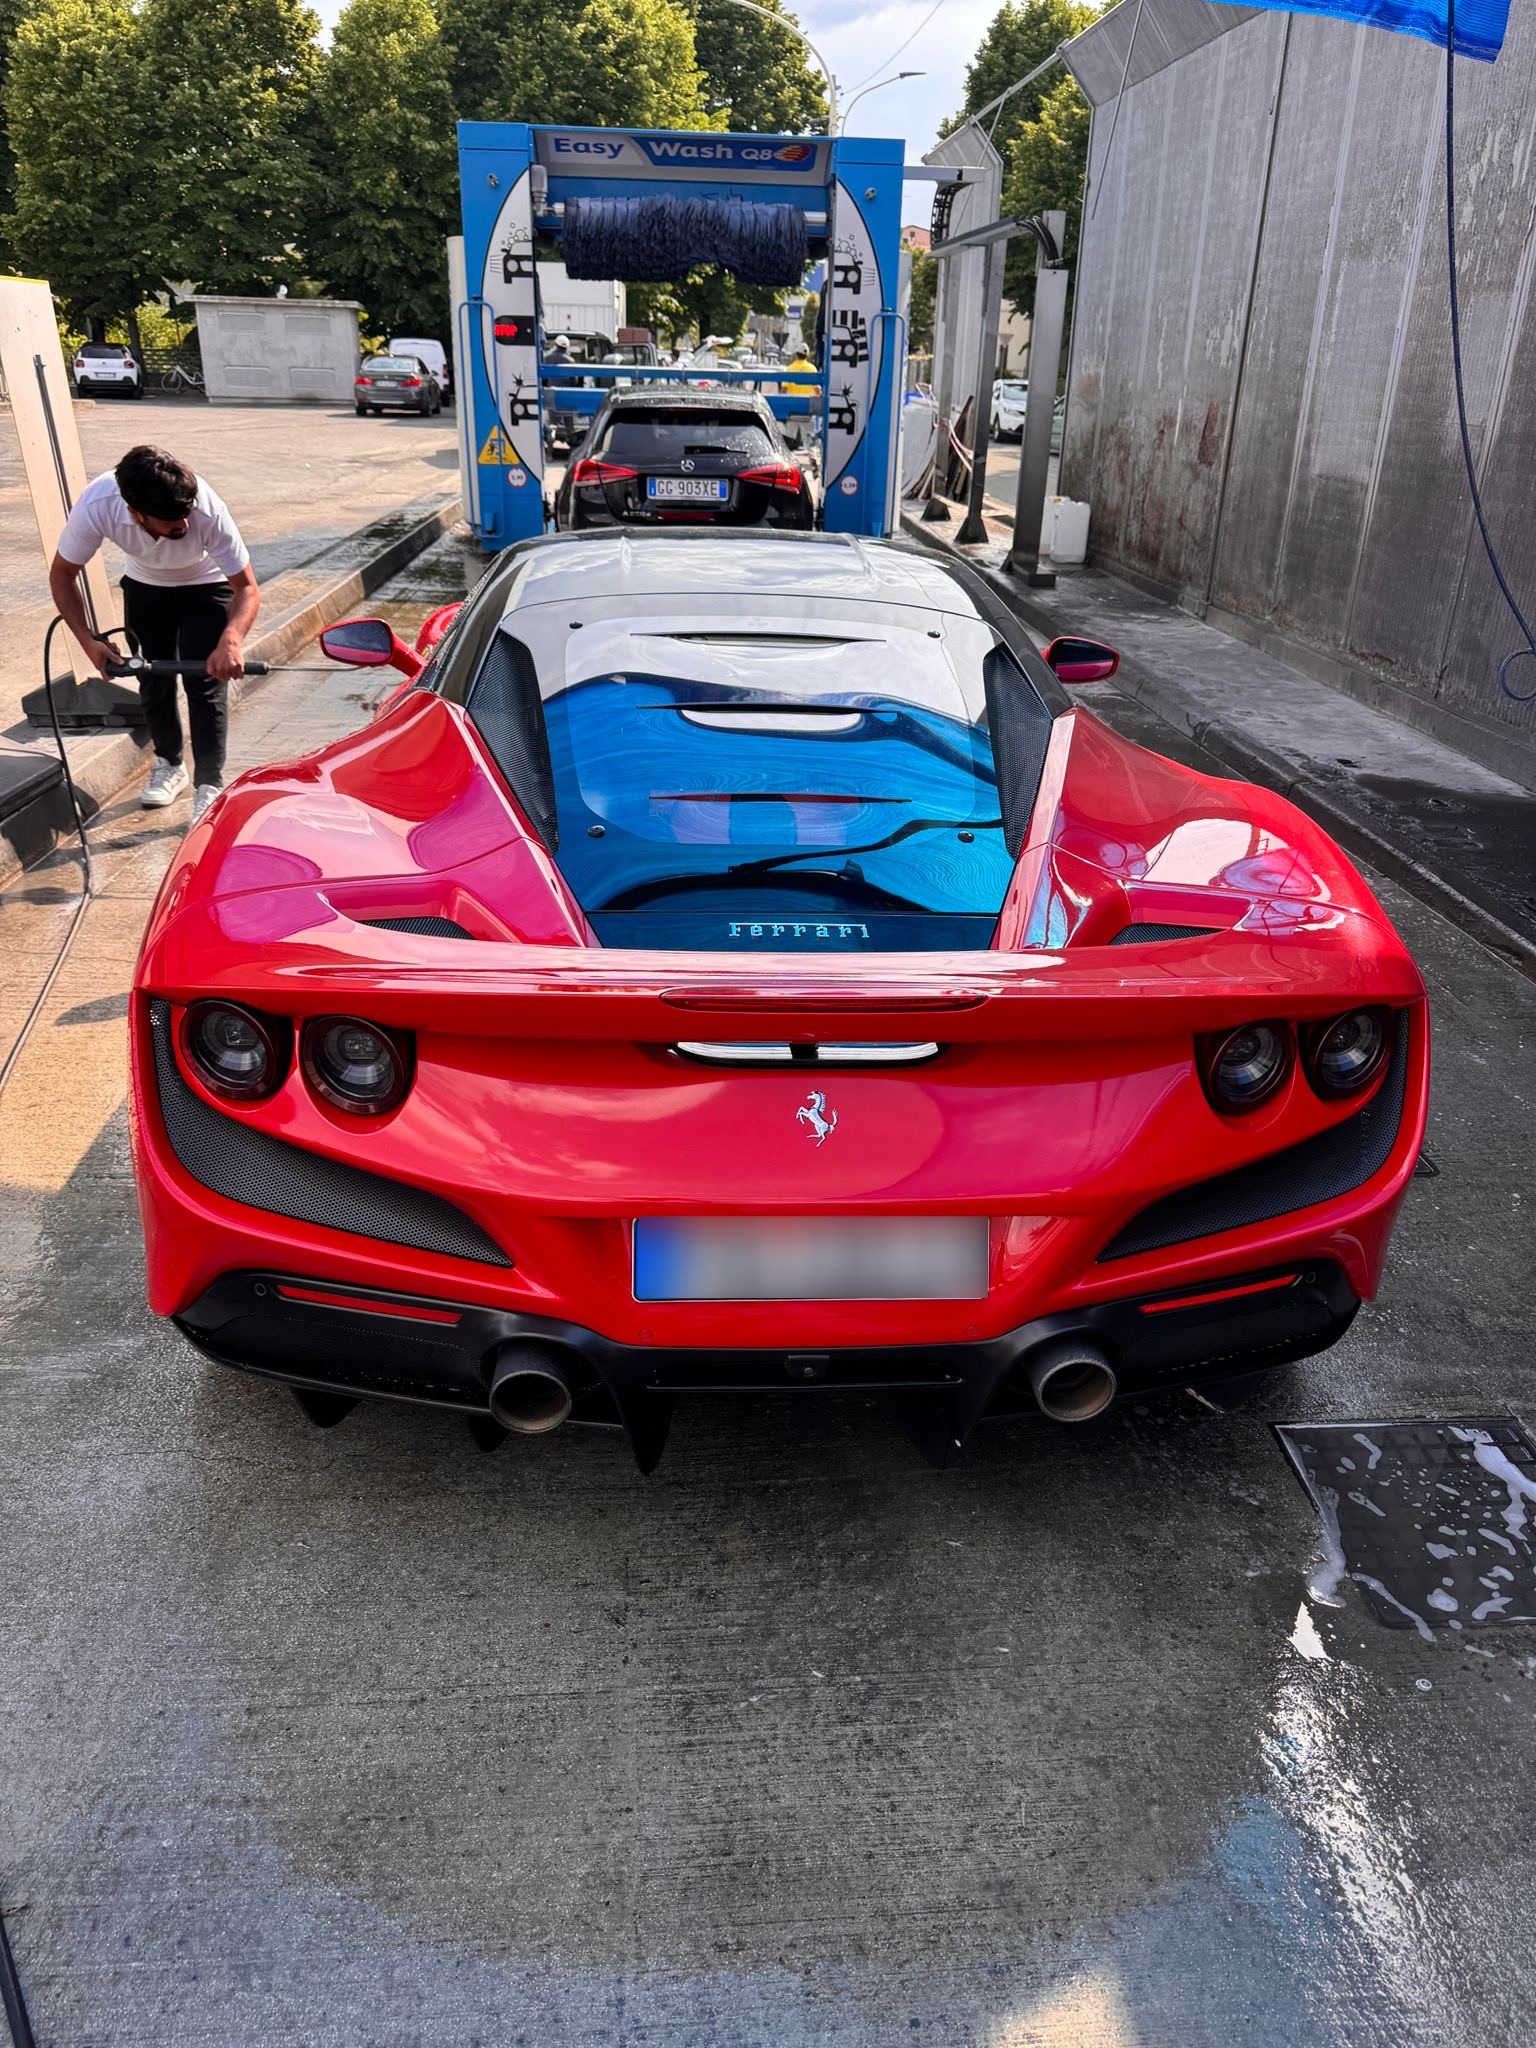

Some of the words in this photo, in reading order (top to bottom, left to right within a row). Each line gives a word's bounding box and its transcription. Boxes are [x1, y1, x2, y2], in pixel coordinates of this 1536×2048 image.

[553, 137, 625, 160] Easy
[648, 141, 733, 160] Wash
[740, 148, 772, 161] Q8
[728, 922, 870, 938] Ferrari
